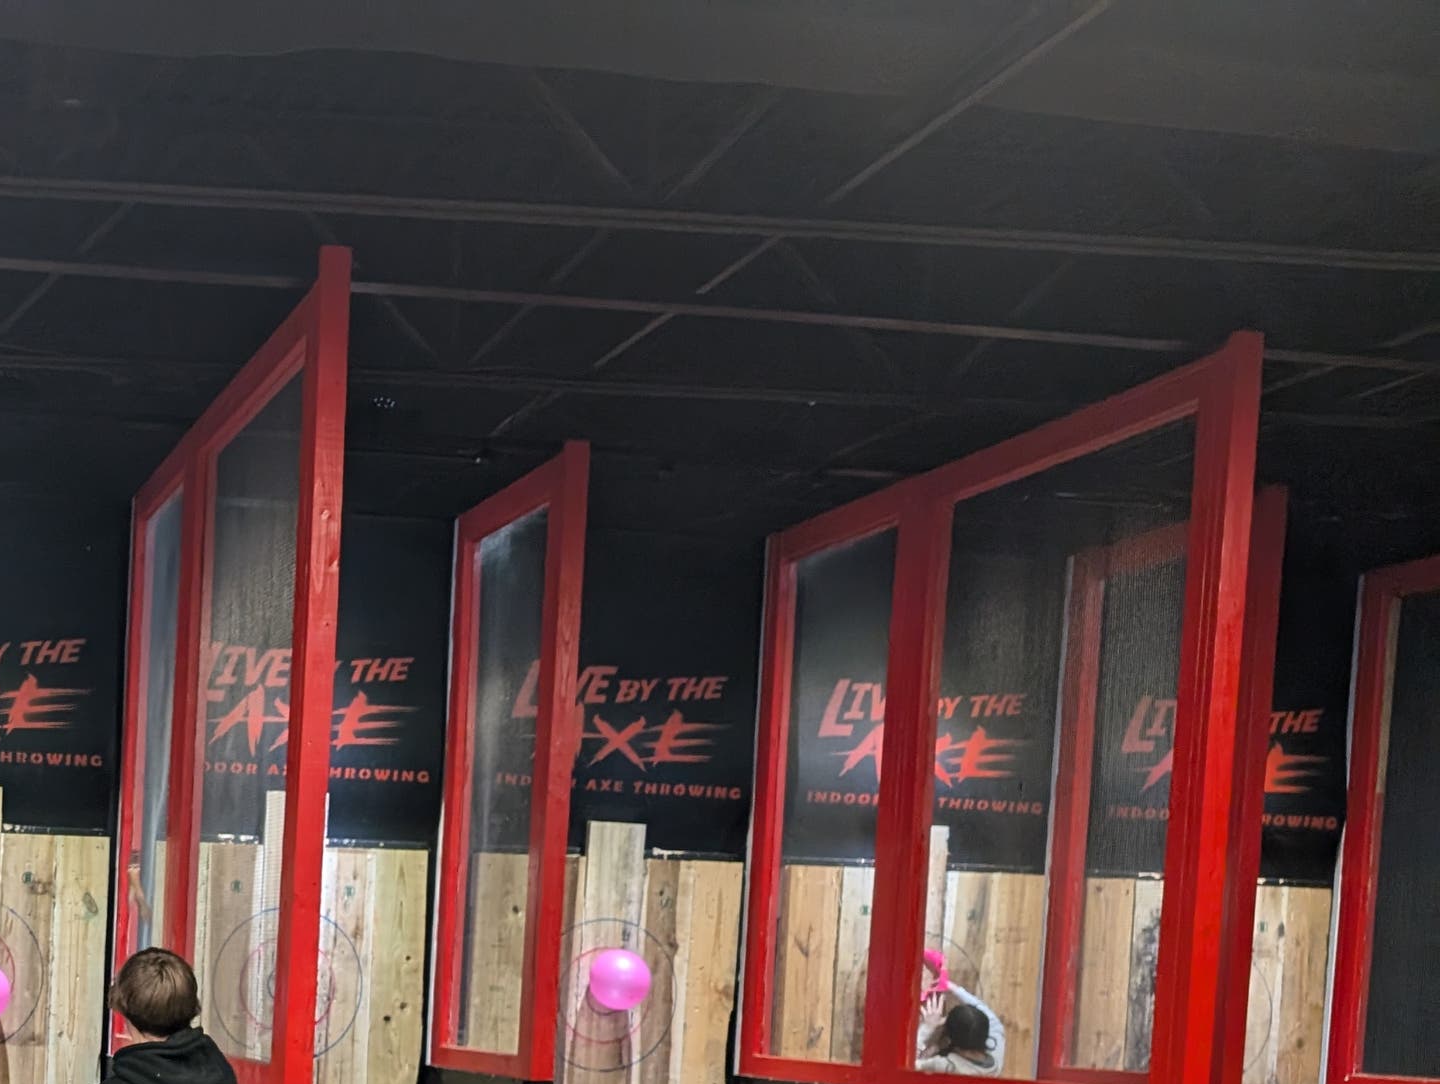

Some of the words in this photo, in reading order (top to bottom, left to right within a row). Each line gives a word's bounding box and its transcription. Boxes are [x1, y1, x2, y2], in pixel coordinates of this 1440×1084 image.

[20, 637, 87, 666] THE
[350, 657, 415, 683] THE
[615, 679, 661, 704] BY
[667, 676, 728, 701] THE
[817, 679, 887, 738] LIV
[971, 694, 1027, 718] THE
[1269, 708, 1325, 734] THE
[329, 767, 430, 783] HROWING
[585, 778, 624, 793] AXE
[633, 780, 742, 799] THROWING
[938, 797, 1044, 816] THROWING
[1109, 804, 1170, 821] INDOO
